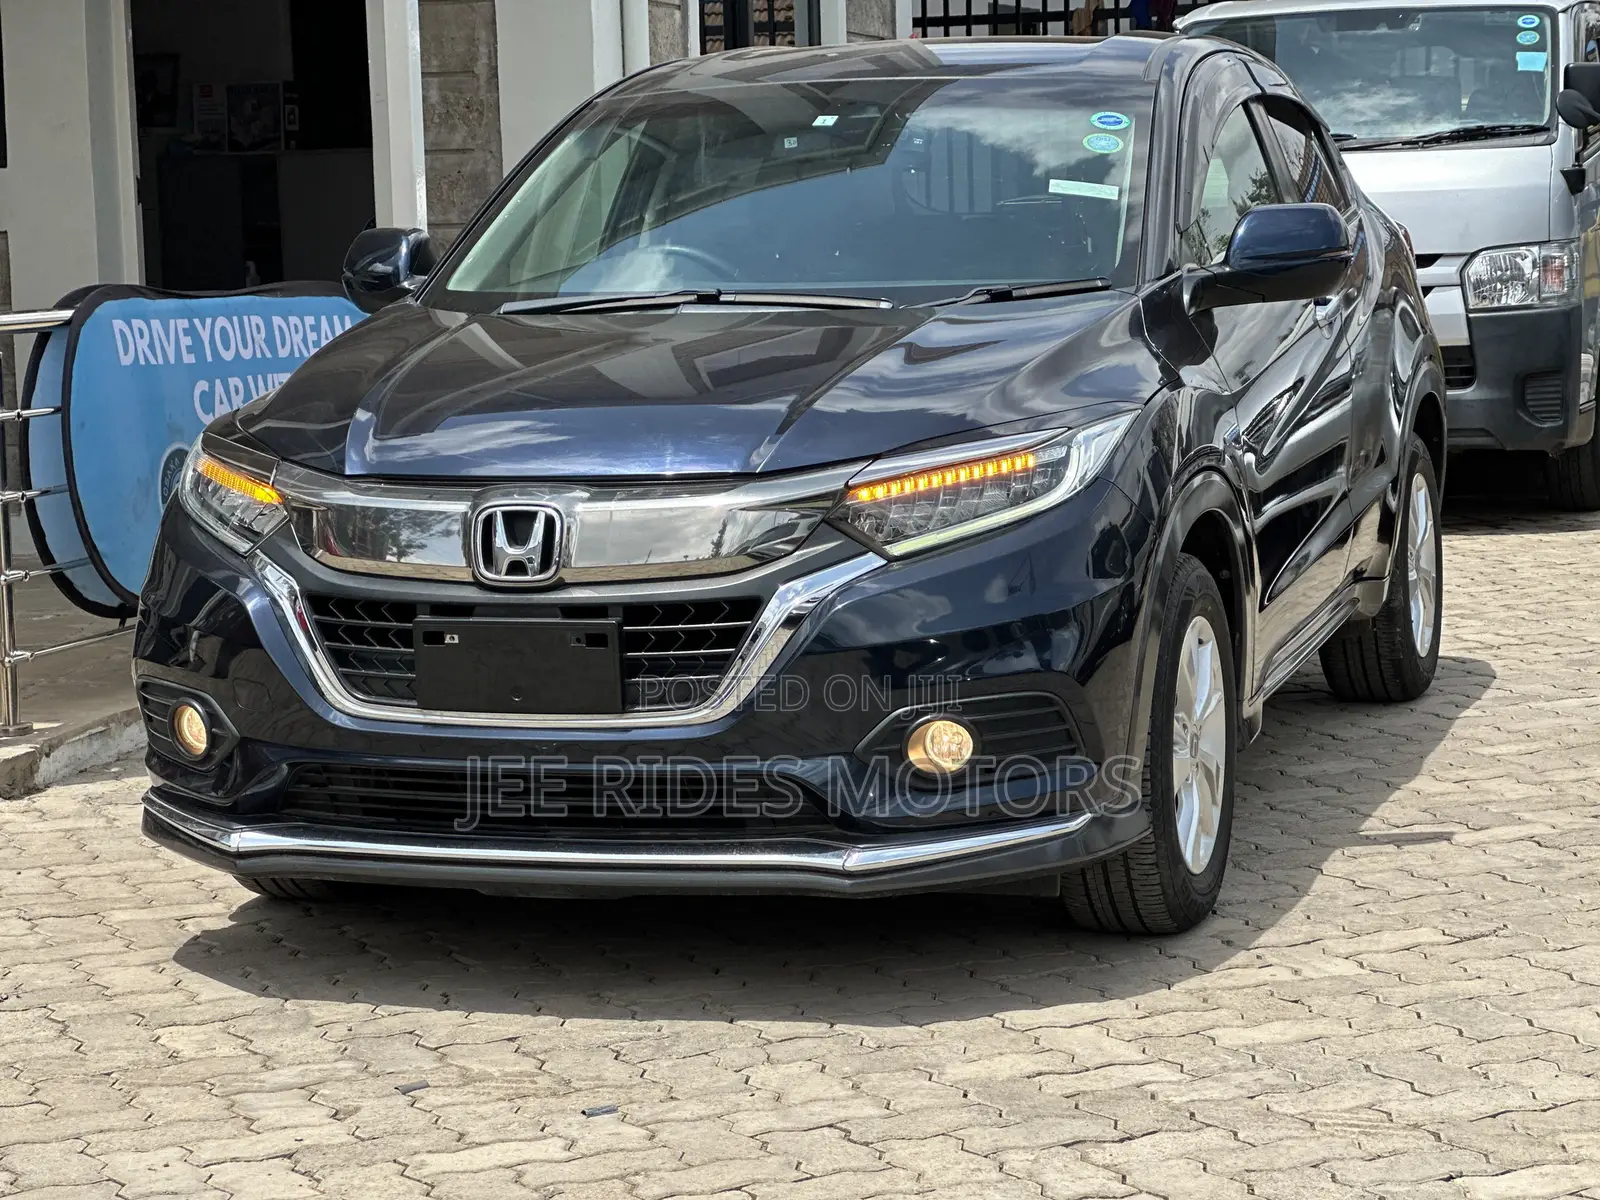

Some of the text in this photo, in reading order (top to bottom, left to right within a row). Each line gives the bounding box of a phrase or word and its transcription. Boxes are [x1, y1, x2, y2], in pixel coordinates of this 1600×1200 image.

[112, 318, 196, 366] DRIVE
[196, 315, 272, 362] YOUR
[193, 376, 245, 426] CAR
